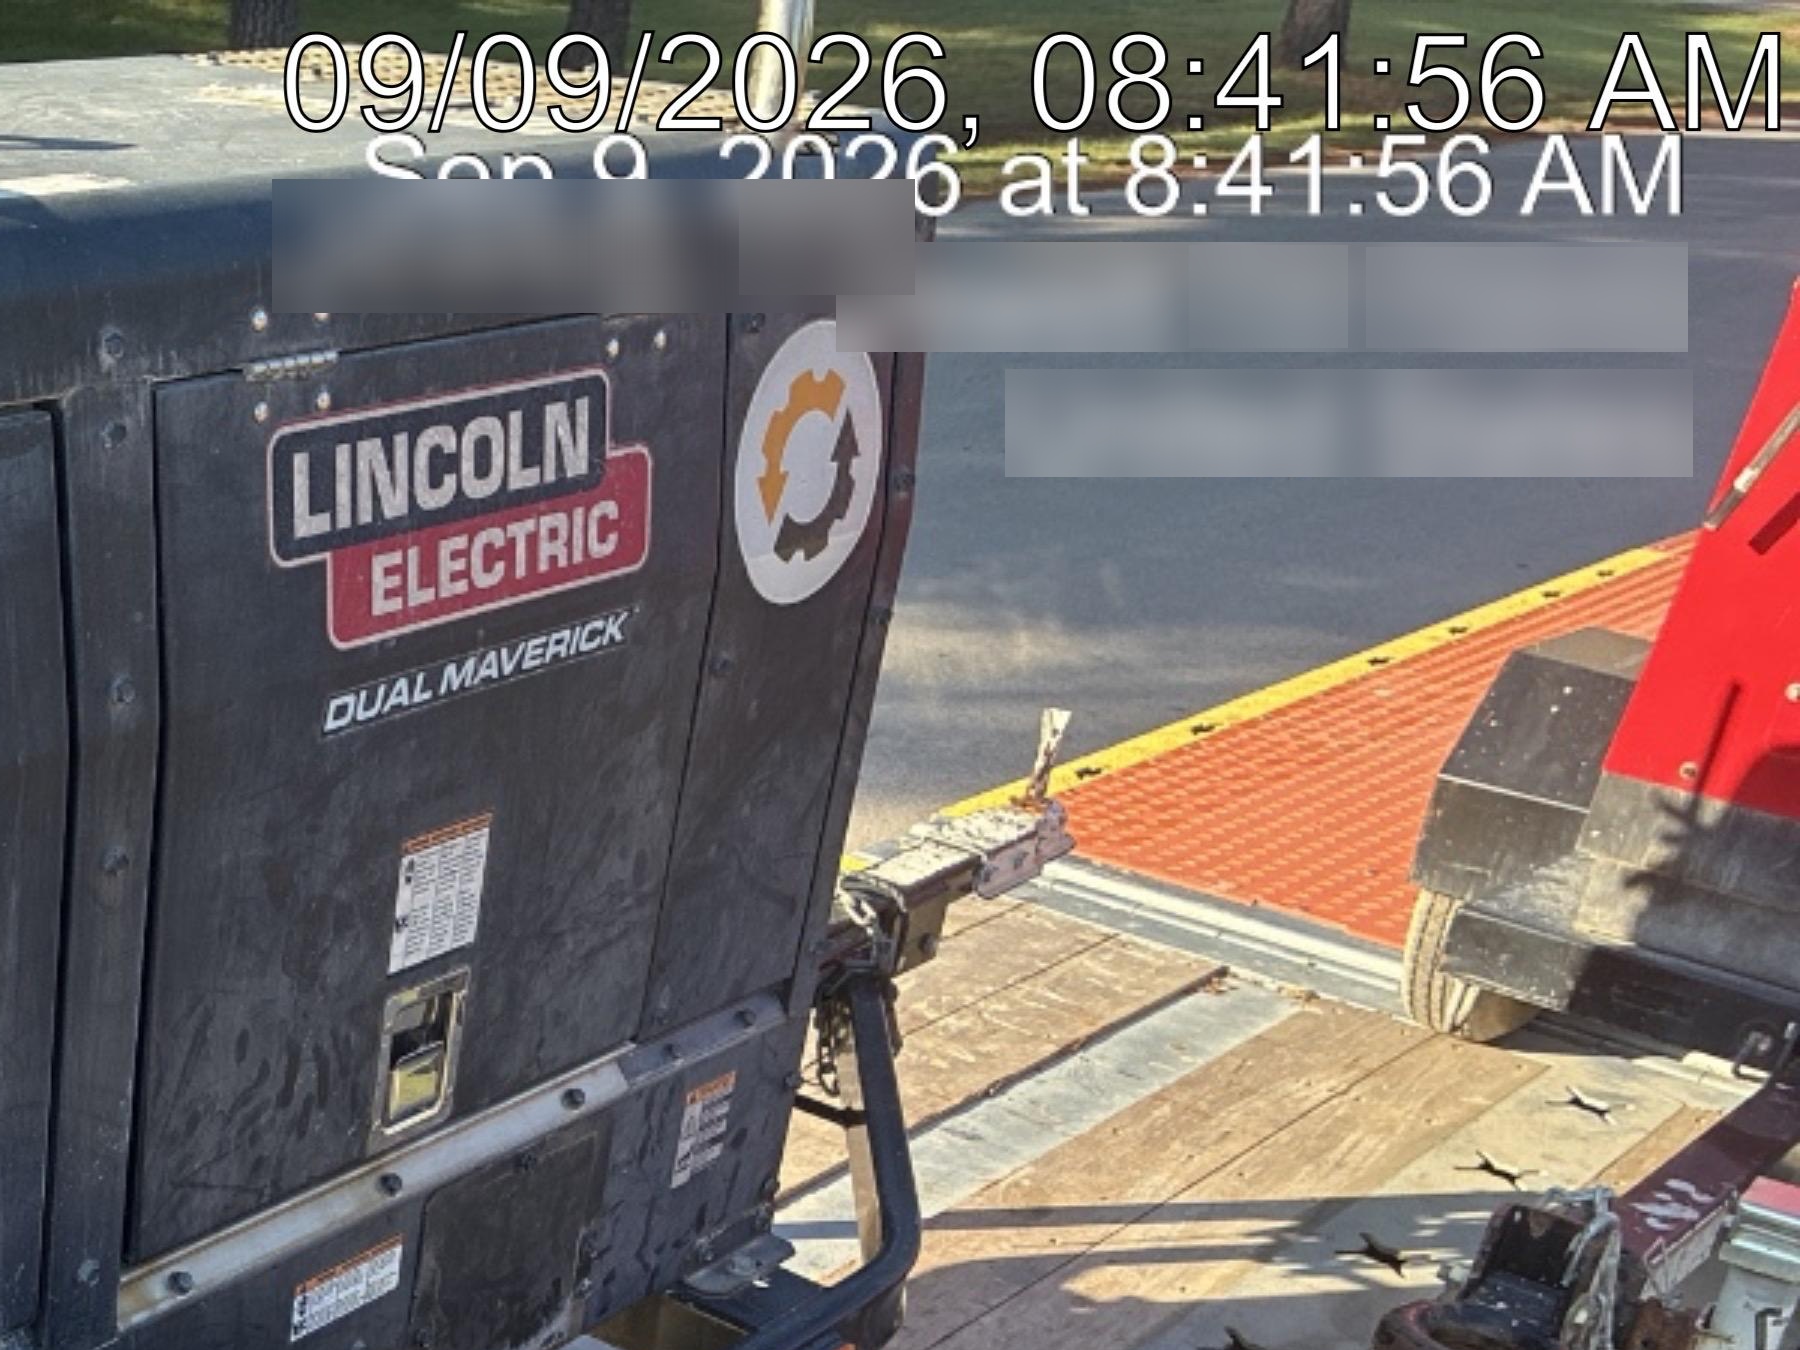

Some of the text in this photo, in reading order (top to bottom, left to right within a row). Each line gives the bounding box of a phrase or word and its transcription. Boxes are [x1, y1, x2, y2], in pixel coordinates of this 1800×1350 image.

[292, 396, 591, 540] LINCOLN
[370, 500, 619, 617] ELECTRIC
[322, 610, 630, 733] DUAL MAVERICK
